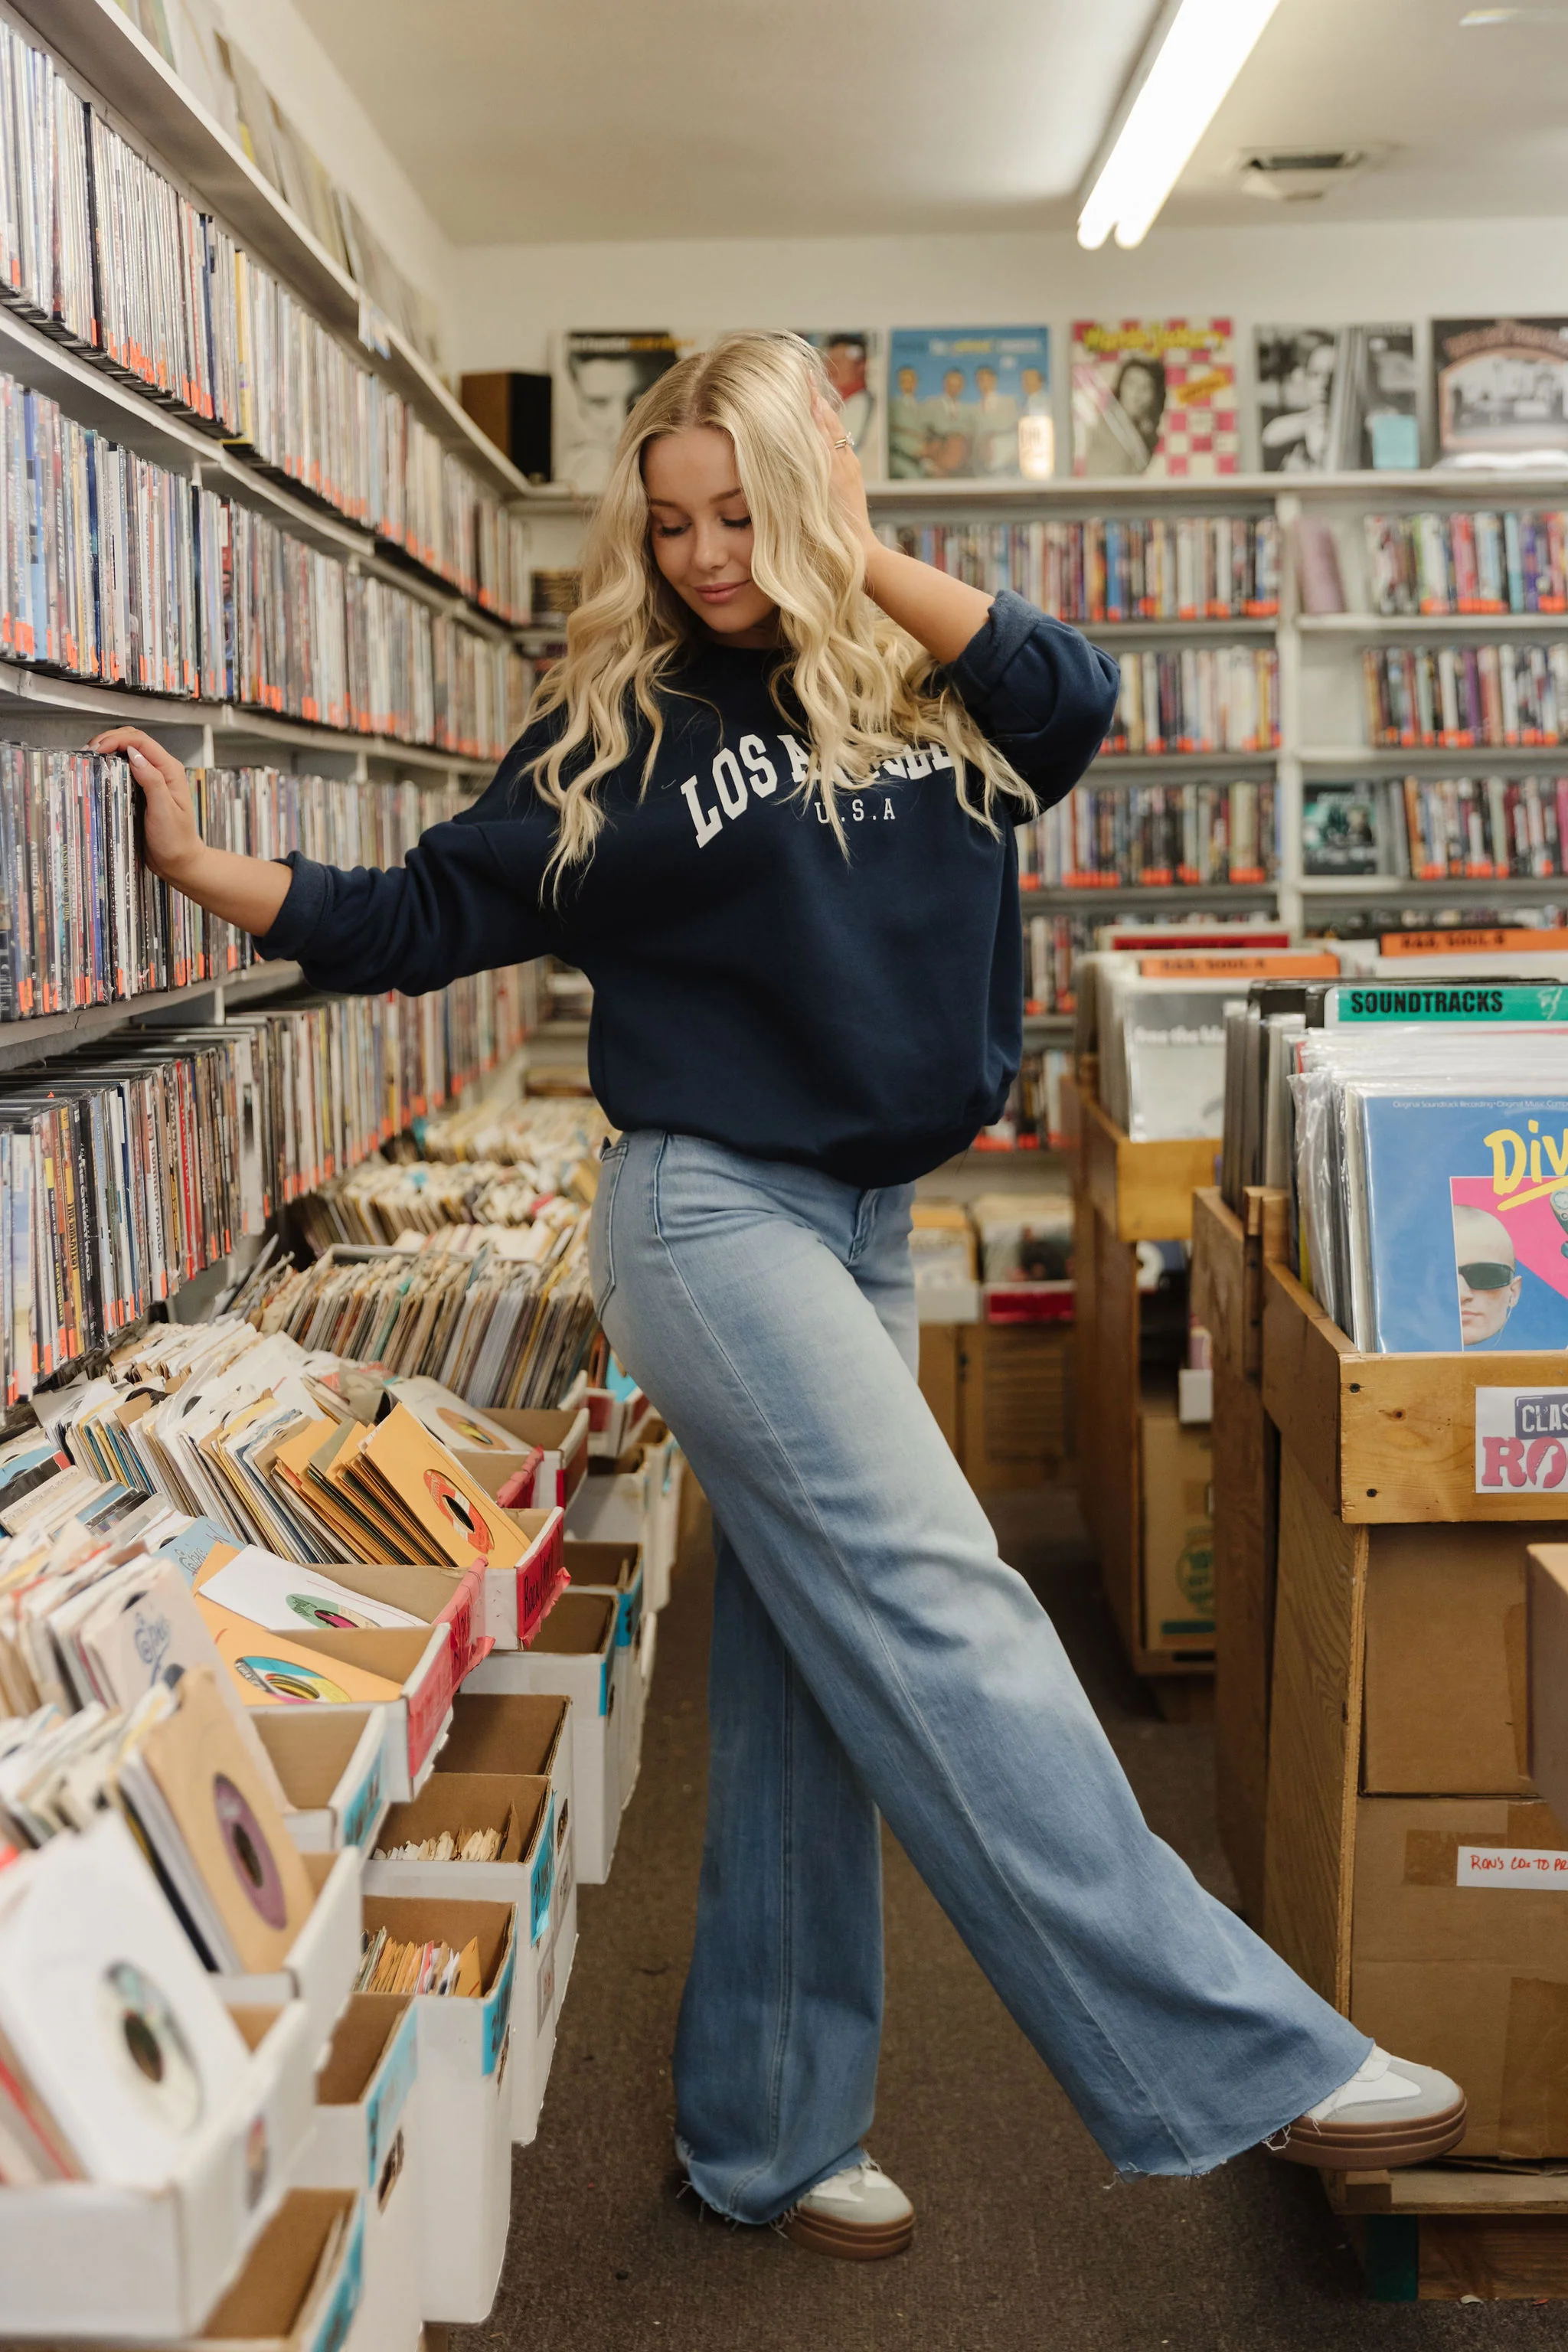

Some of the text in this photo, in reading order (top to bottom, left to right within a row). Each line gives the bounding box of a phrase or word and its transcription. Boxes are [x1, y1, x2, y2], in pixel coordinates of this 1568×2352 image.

[681, 734, 778, 848] LOS
[1351, 991, 1503, 1014] SOUNDTRACKS
[1393, 1100, 1420, 1109] Original
[1460, 1100, 1493, 1109] Recording
[1496, 1099, 1524, 1109] Original
[1481, 1436, 1568, 1489] RO
[1533, 1858, 1549, 1870] TO
